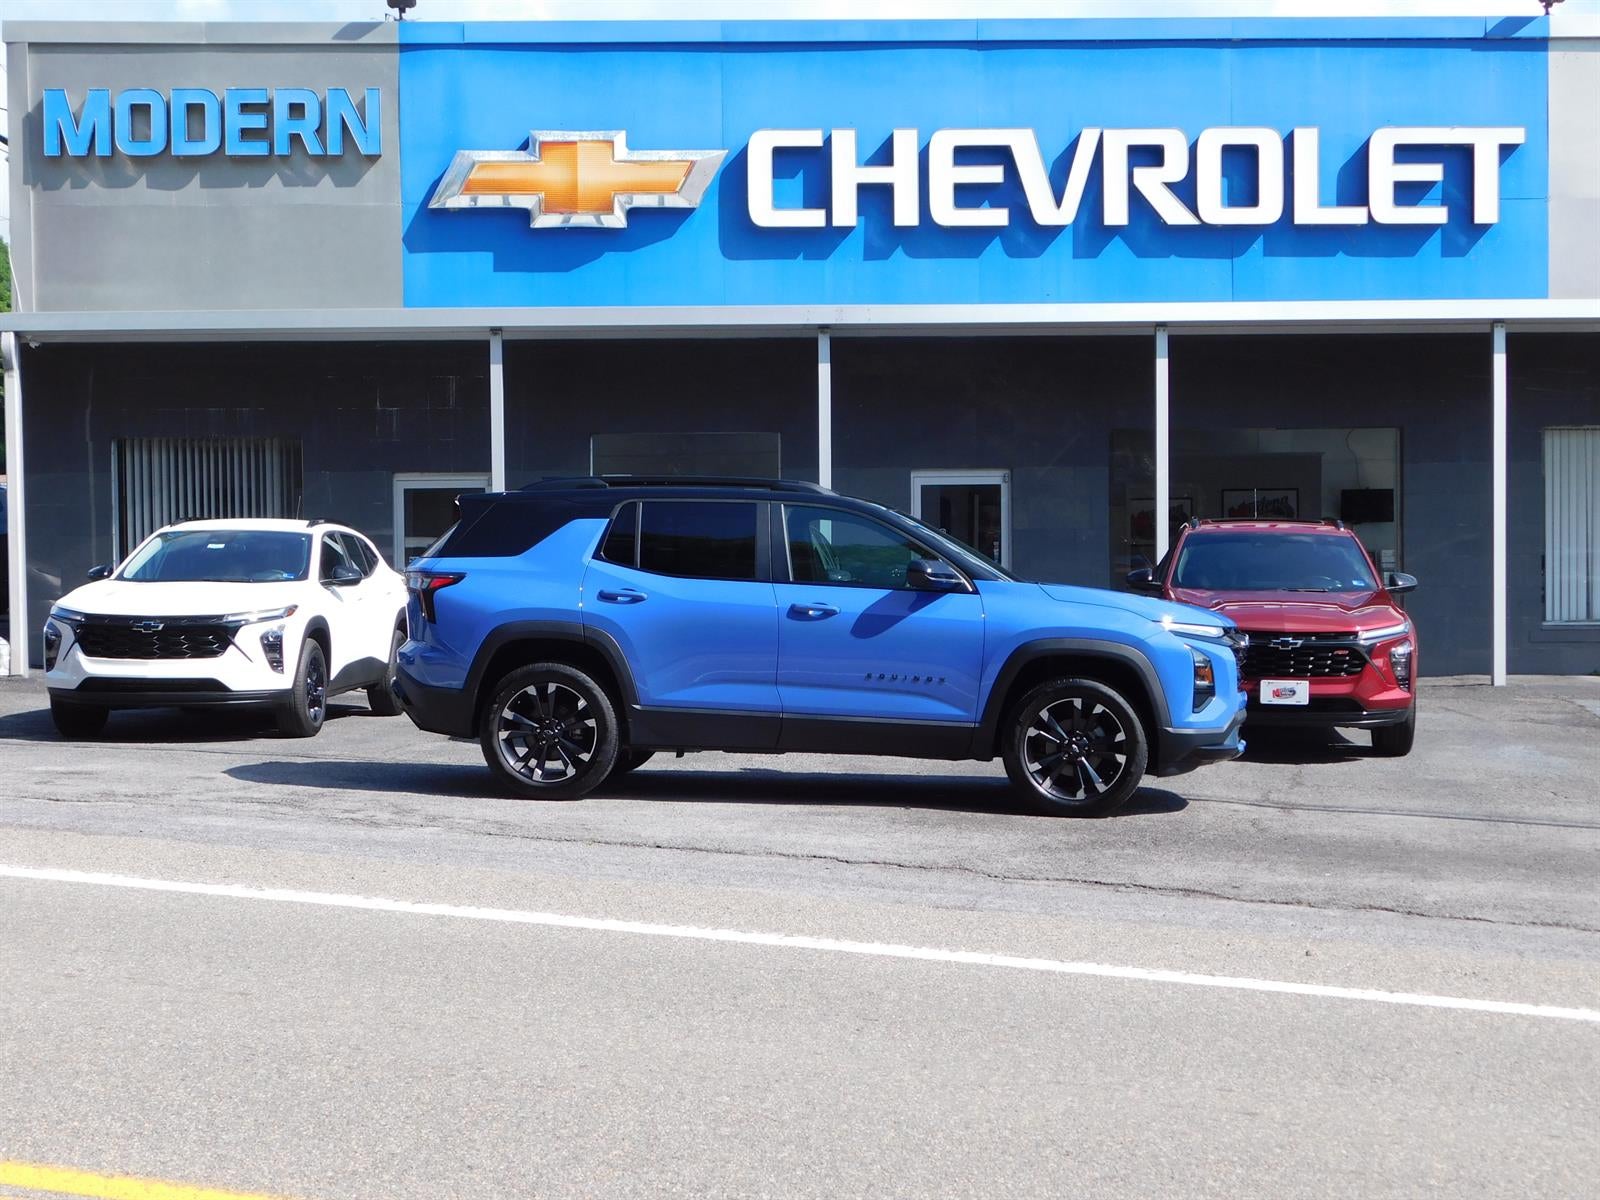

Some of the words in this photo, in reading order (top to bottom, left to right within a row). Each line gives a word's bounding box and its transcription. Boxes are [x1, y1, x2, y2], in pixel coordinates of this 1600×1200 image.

[42, 88, 382, 157] MODERN
[746, 126, 1526, 228] CHEVROLET
[865, 671, 947, 684] EQUINOX
